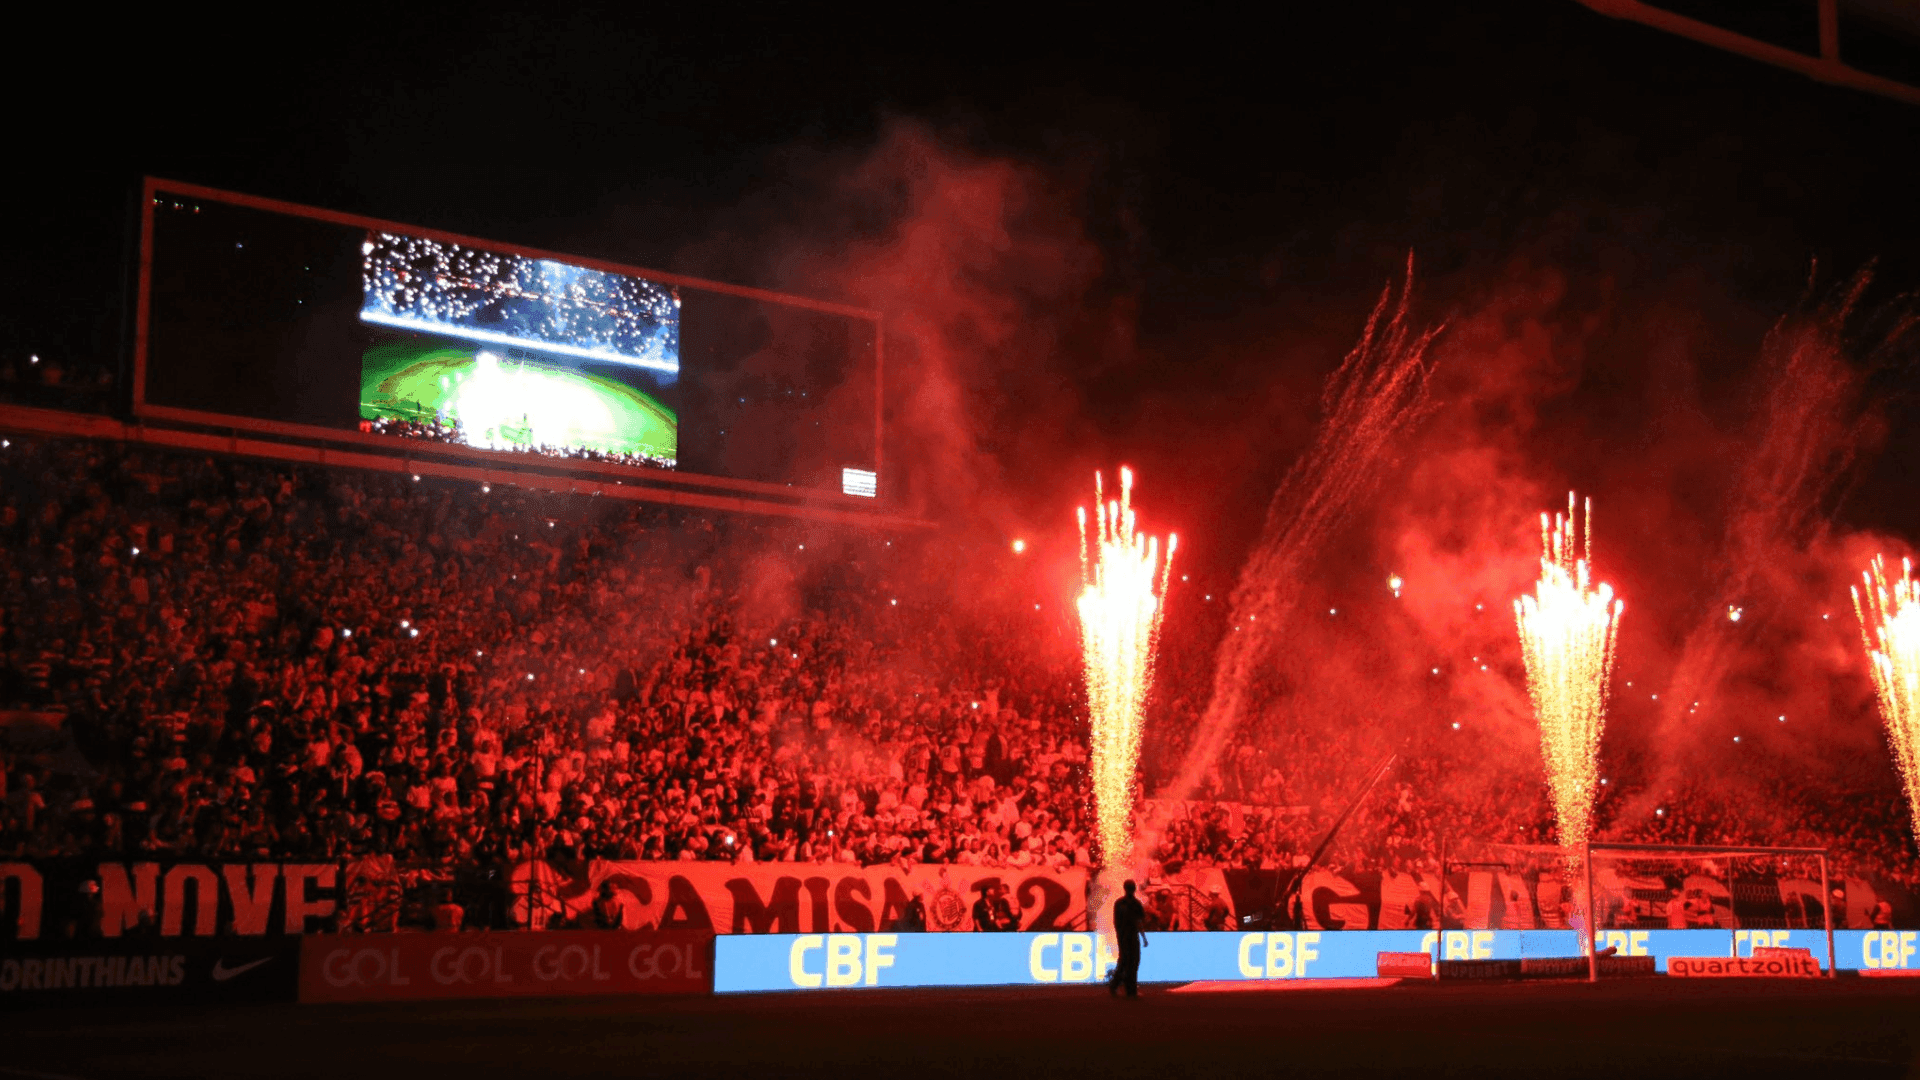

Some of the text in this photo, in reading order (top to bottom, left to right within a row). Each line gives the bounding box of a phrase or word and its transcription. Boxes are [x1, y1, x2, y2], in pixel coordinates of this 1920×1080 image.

[322, 948, 410, 988] GOL
[430, 946, 513, 985] GOL
[533, 944, 610, 981] GOL
[628, 943, 702, 980] GOL
[789, 934, 898, 988] CBF
[1238, 932, 1321, 979] CBF
[1672, 957, 1814, 977] quartzolit
[1863, 930, 1917, 969] CBF
